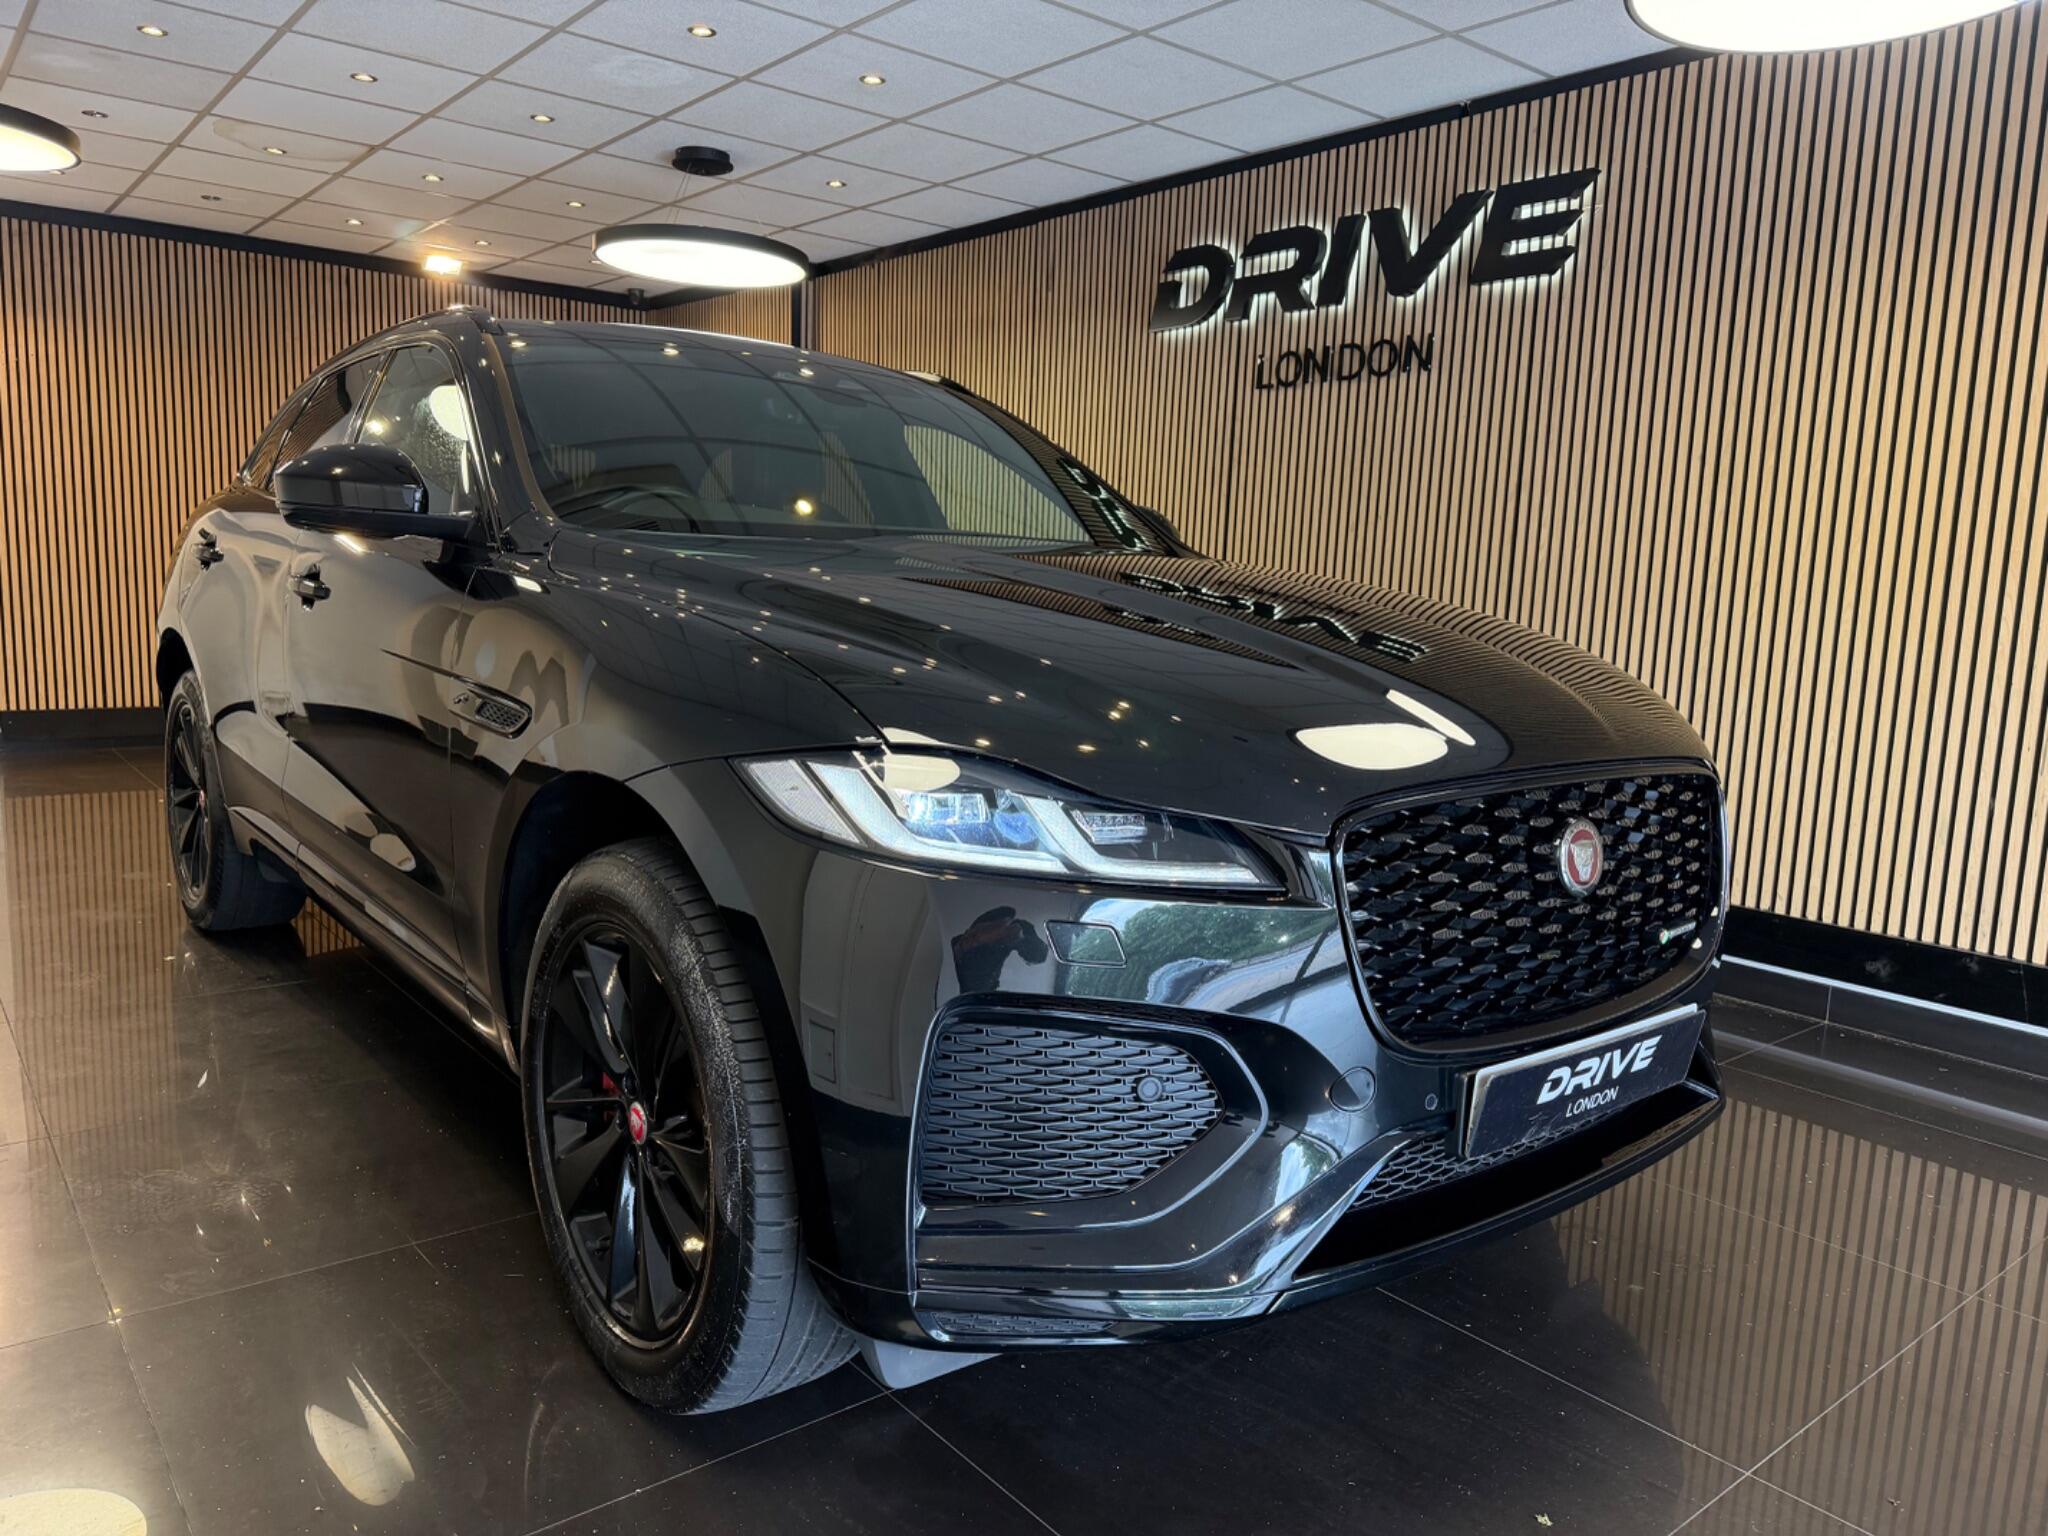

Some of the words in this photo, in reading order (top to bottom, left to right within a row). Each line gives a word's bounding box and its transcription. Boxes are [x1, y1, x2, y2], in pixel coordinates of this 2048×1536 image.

[1150, 167, 1601, 332] DRIVE
[1255, 333, 1434, 389] LONDON
[1536, 1034, 1662, 1105] DRIVE
[1565, 1086, 1619, 1118] LONDON
